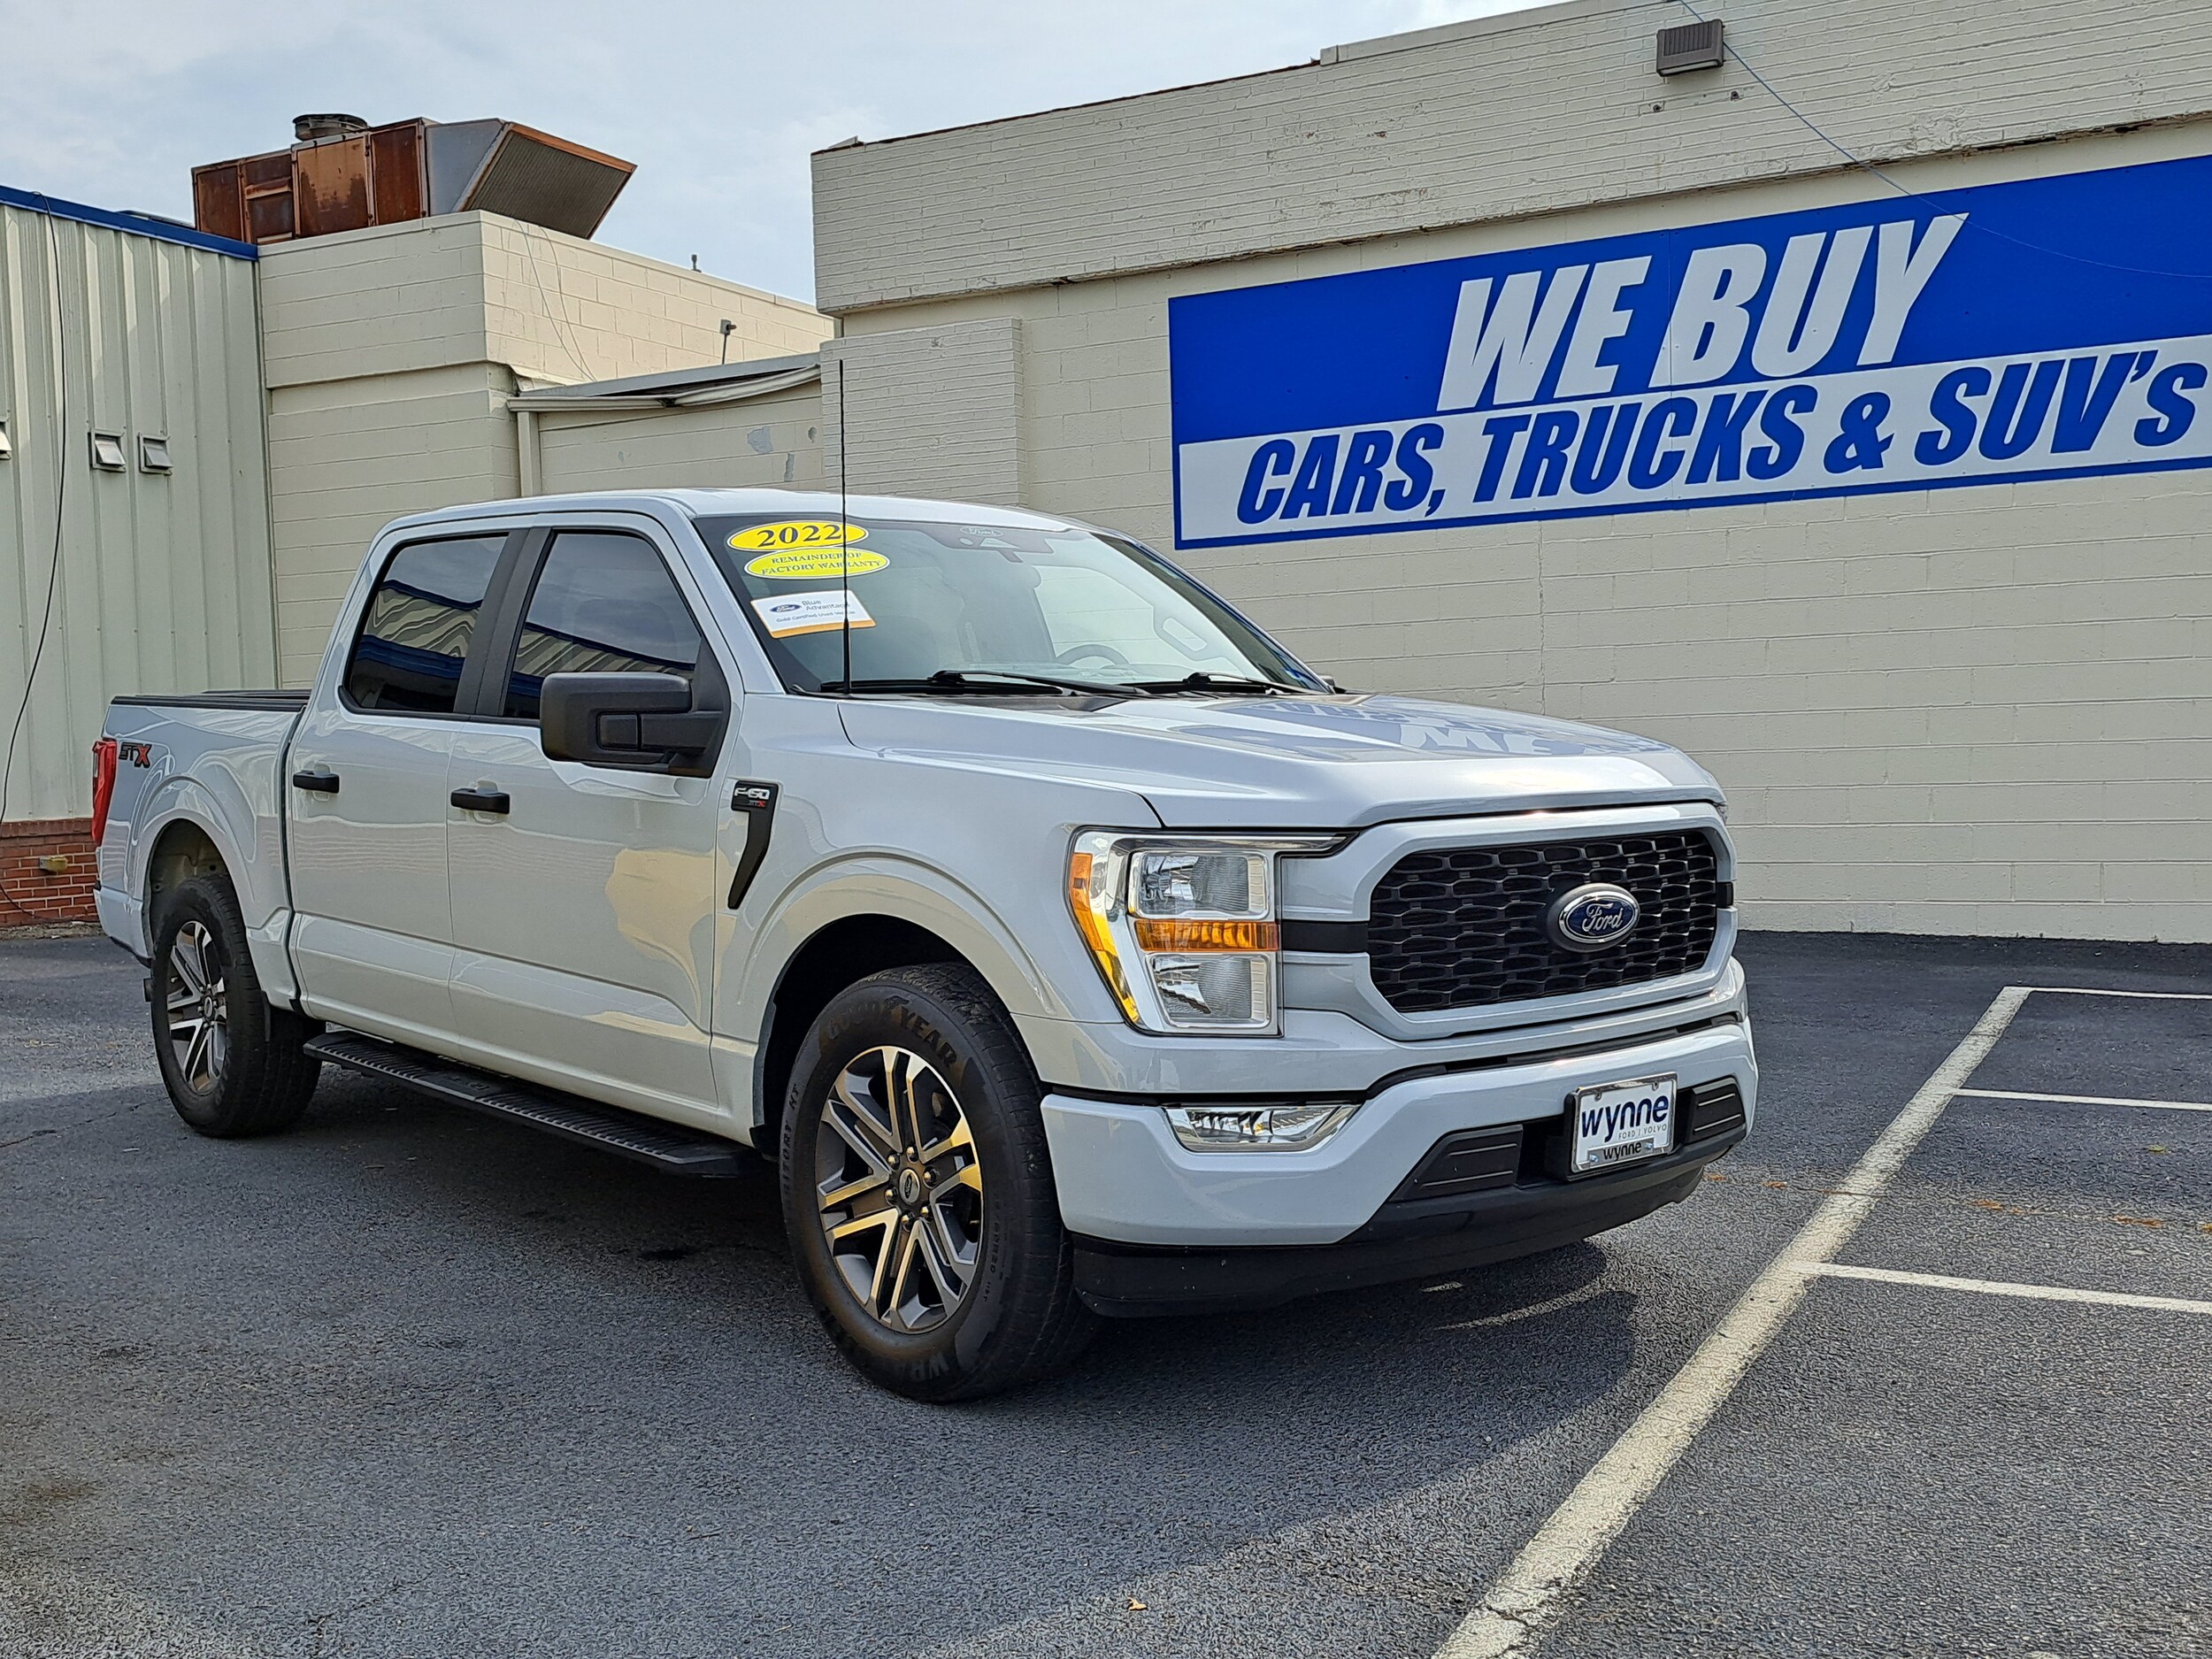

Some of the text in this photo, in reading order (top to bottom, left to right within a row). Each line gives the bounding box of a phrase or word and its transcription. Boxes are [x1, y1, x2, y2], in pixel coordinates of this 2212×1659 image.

[1437, 212, 1970, 411] WE BUY
[1238, 349, 2208, 518] CARS, TRUCKS & SUV'S
[757, 524, 841, 548] 2022
[761, 564, 814, 575] FACTORY
[772, 553, 843, 565] REMAINDER
[119, 741, 152, 768] STX
[1582, 902, 1624, 933] Ford
[1581, 1095, 1670, 1142] wynne
[1618, 1129, 1636, 1141] FORD
[1644, 1124, 1668, 1134] VOLVO
[1603, 1141, 1642, 1161] wynne
